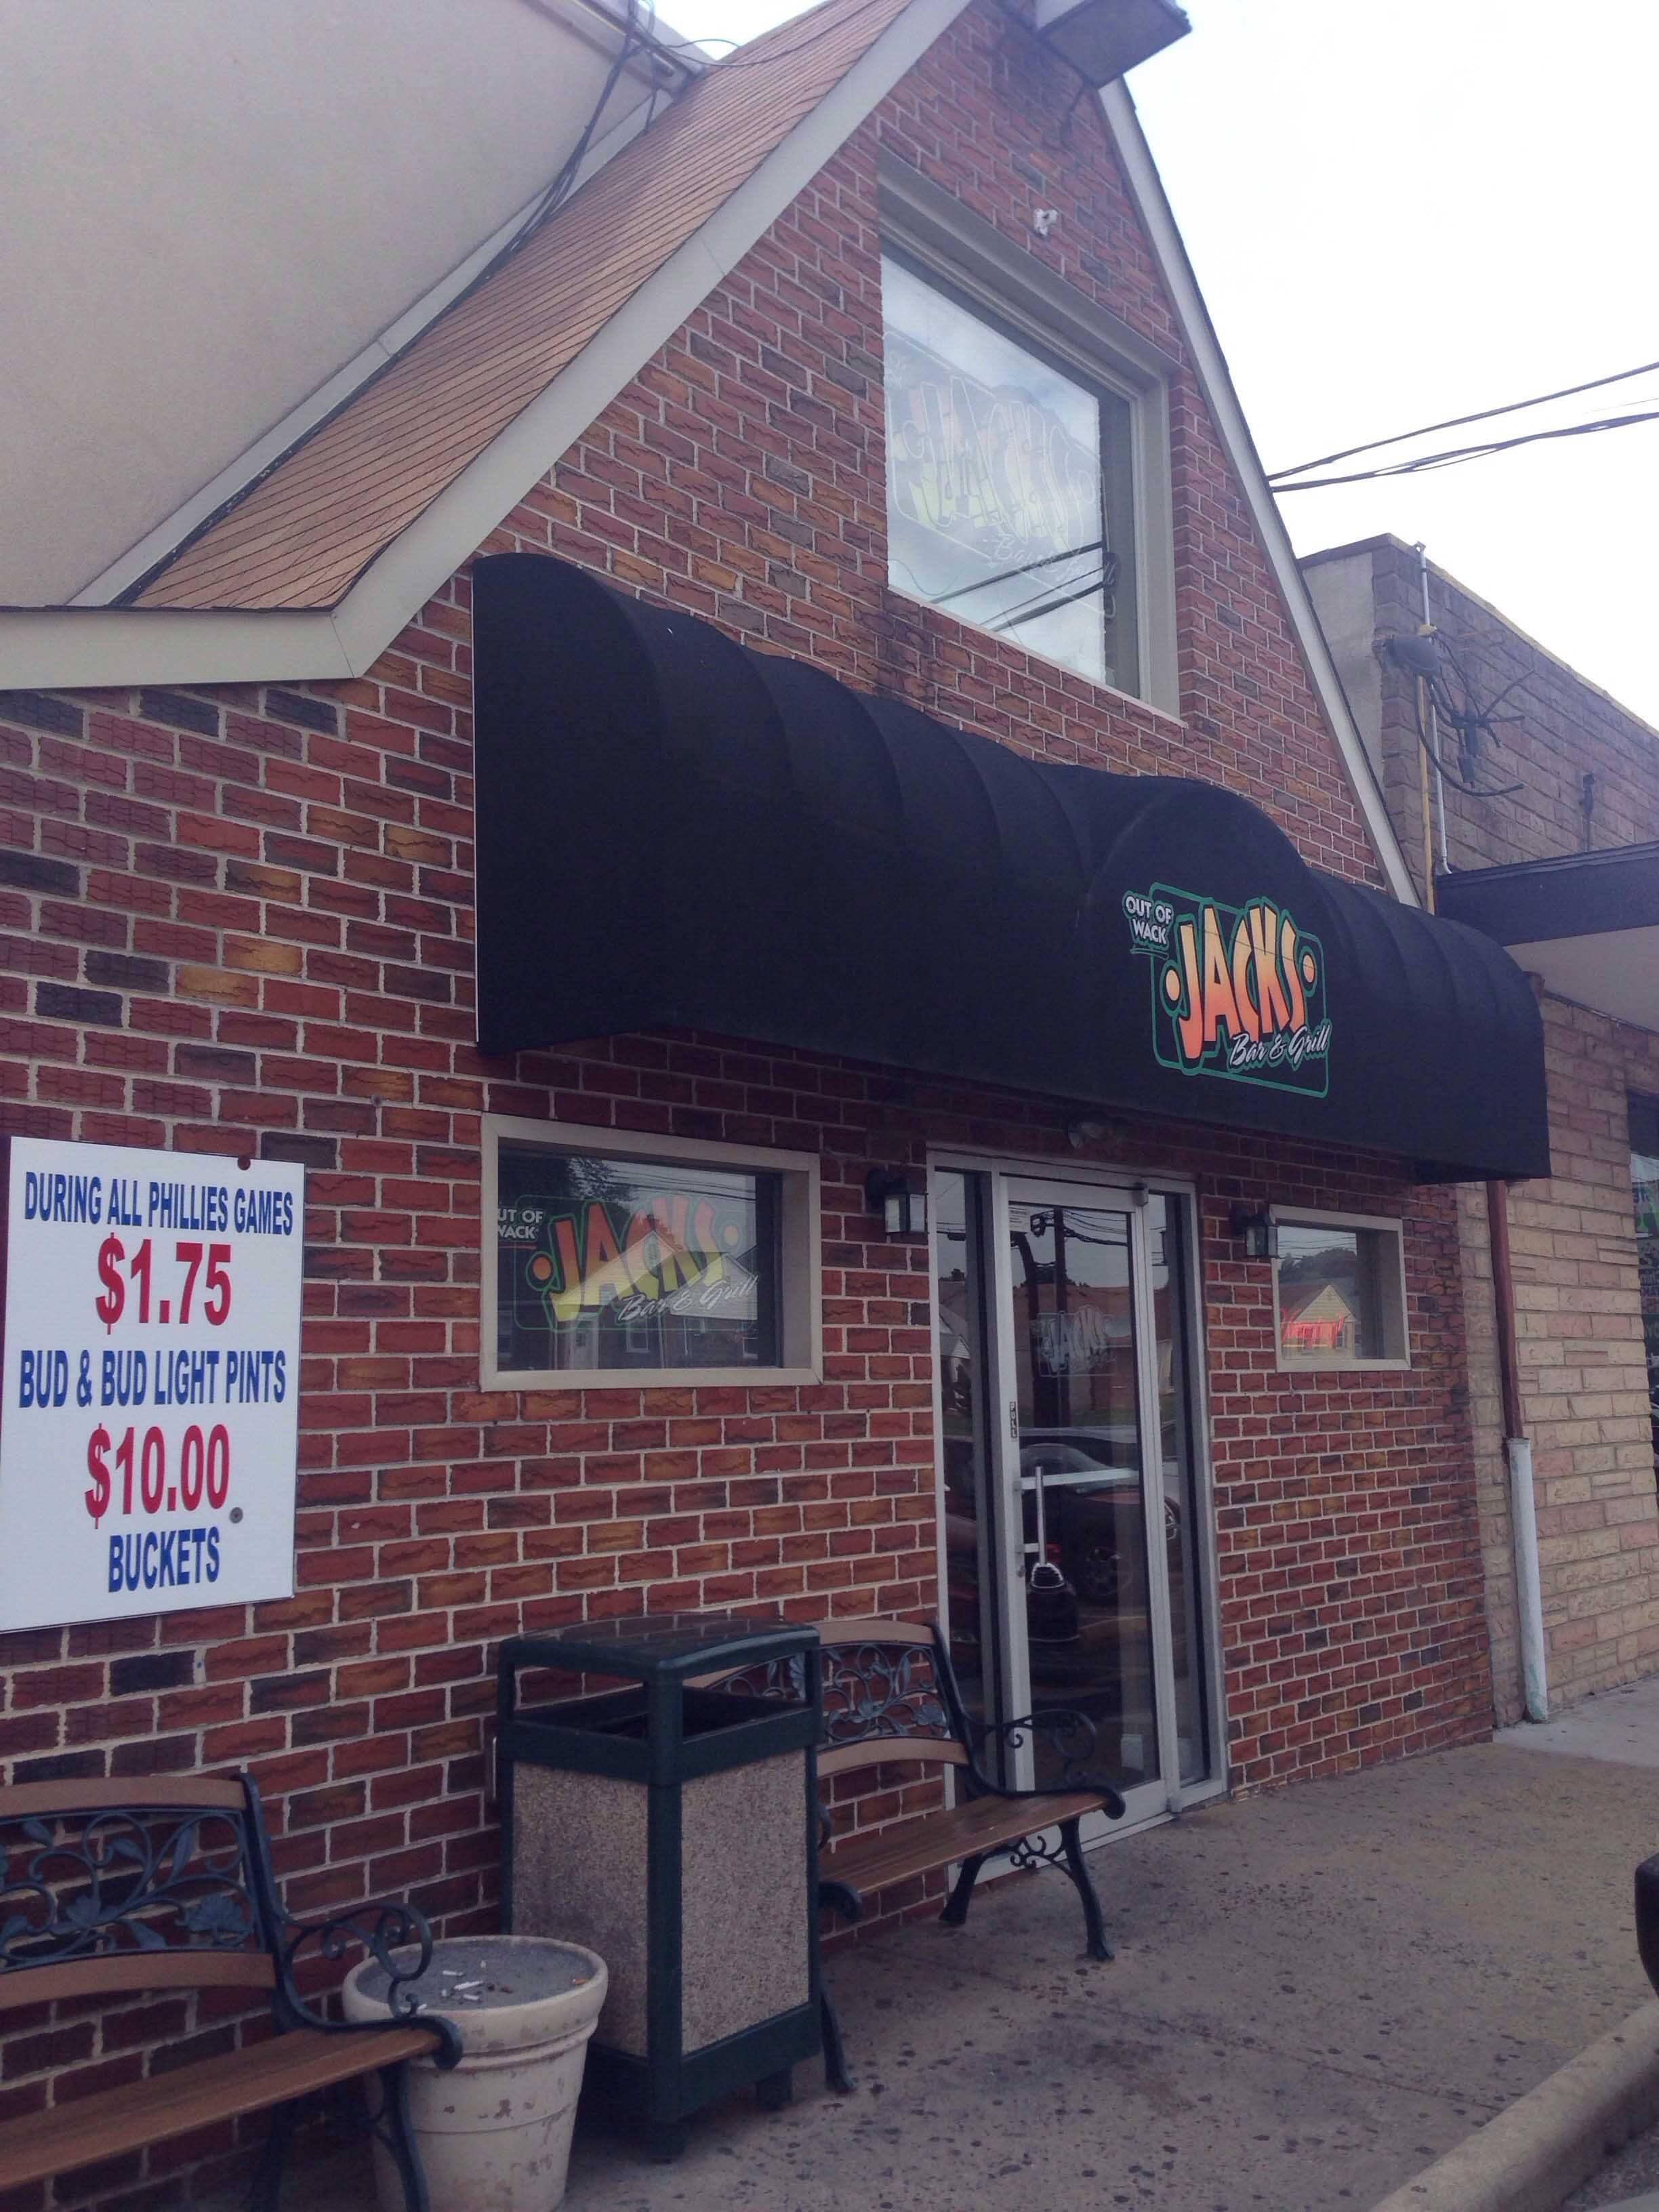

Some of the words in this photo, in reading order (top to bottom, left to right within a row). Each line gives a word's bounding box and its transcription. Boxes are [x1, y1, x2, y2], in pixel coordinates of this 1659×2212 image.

[1126, 896, 1151, 918] OUT
[1155, 905, 1172, 924] OF
[1132, 918, 1166, 944] WACK
[1179, 904, 1306, 1059] JACKS
[1230, 1033, 1268, 1065] Bar
[1270, 1033, 1287, 1059] &
[1288, 1024, 1330, 1064] Grill
[25, 1172, 102, 1224] DURING
[108, 1179, 142, 1227] ALL
[149, 1182, 228, 1232] PHILLIES
[234, 1187, 293, 1235] GAMES
[498, 1208, 517, 1222] UT
[522, 1210, 544, 1223] OF
[96, 1232, 232, 1335] $1.75
[550, 1195, 724, 1322] JACKS
[617, 1293, 669, 1321] Bar
[20, 1350, 68, 1408] BUD
[77, 1351, 93, 1407] &
[102, 1350, 147, 1406] BUD
[155, 1351, 220, 1405] LIGHT
[226, 1351, 287, 1404] PINTS
[85, 1423, 230, 1530] $10.00
[108, 1526, 220, 1593] BUCKETS
